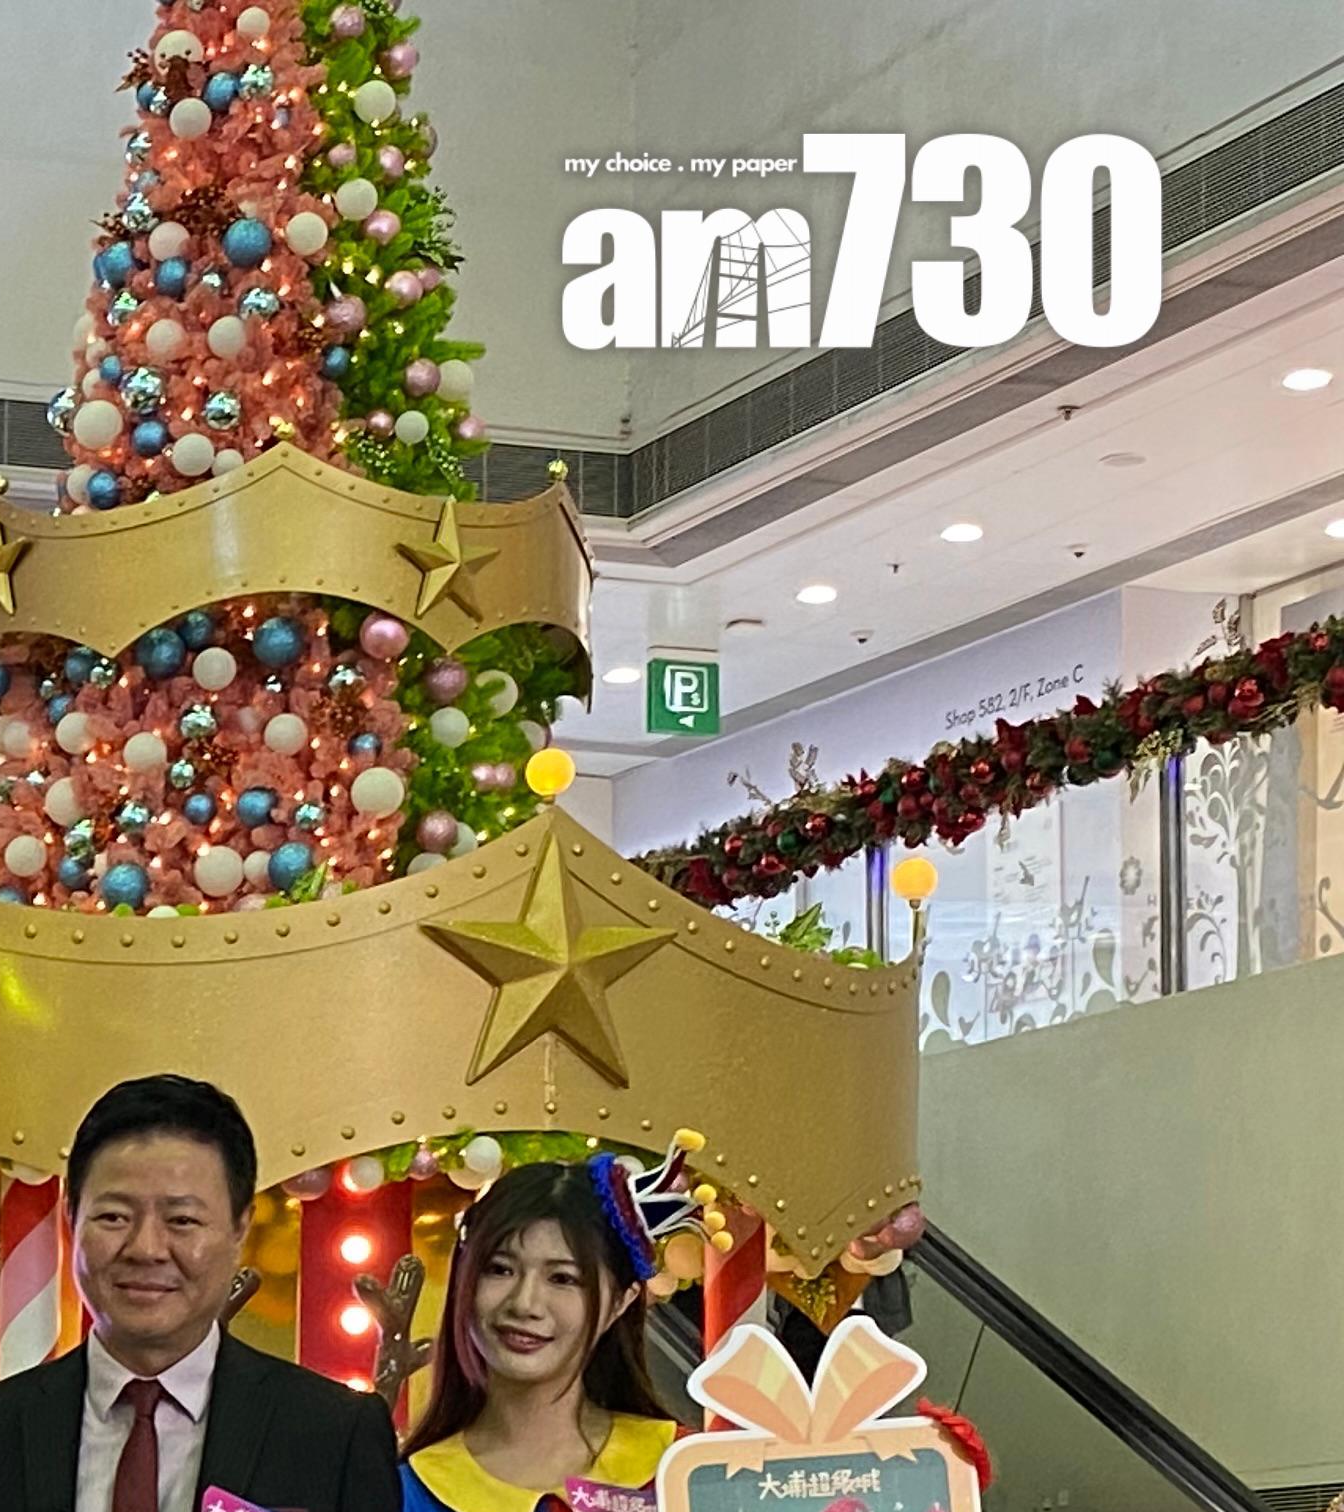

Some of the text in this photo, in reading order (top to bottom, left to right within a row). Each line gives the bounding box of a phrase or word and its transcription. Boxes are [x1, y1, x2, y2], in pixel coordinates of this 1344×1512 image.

[945, 709, 977, 731] Shop
[1037, 675, 1070, 699] Zone
[1072, 663, 1085, 685] C
[758, 1468, 882, 1501] 大埔超級城
